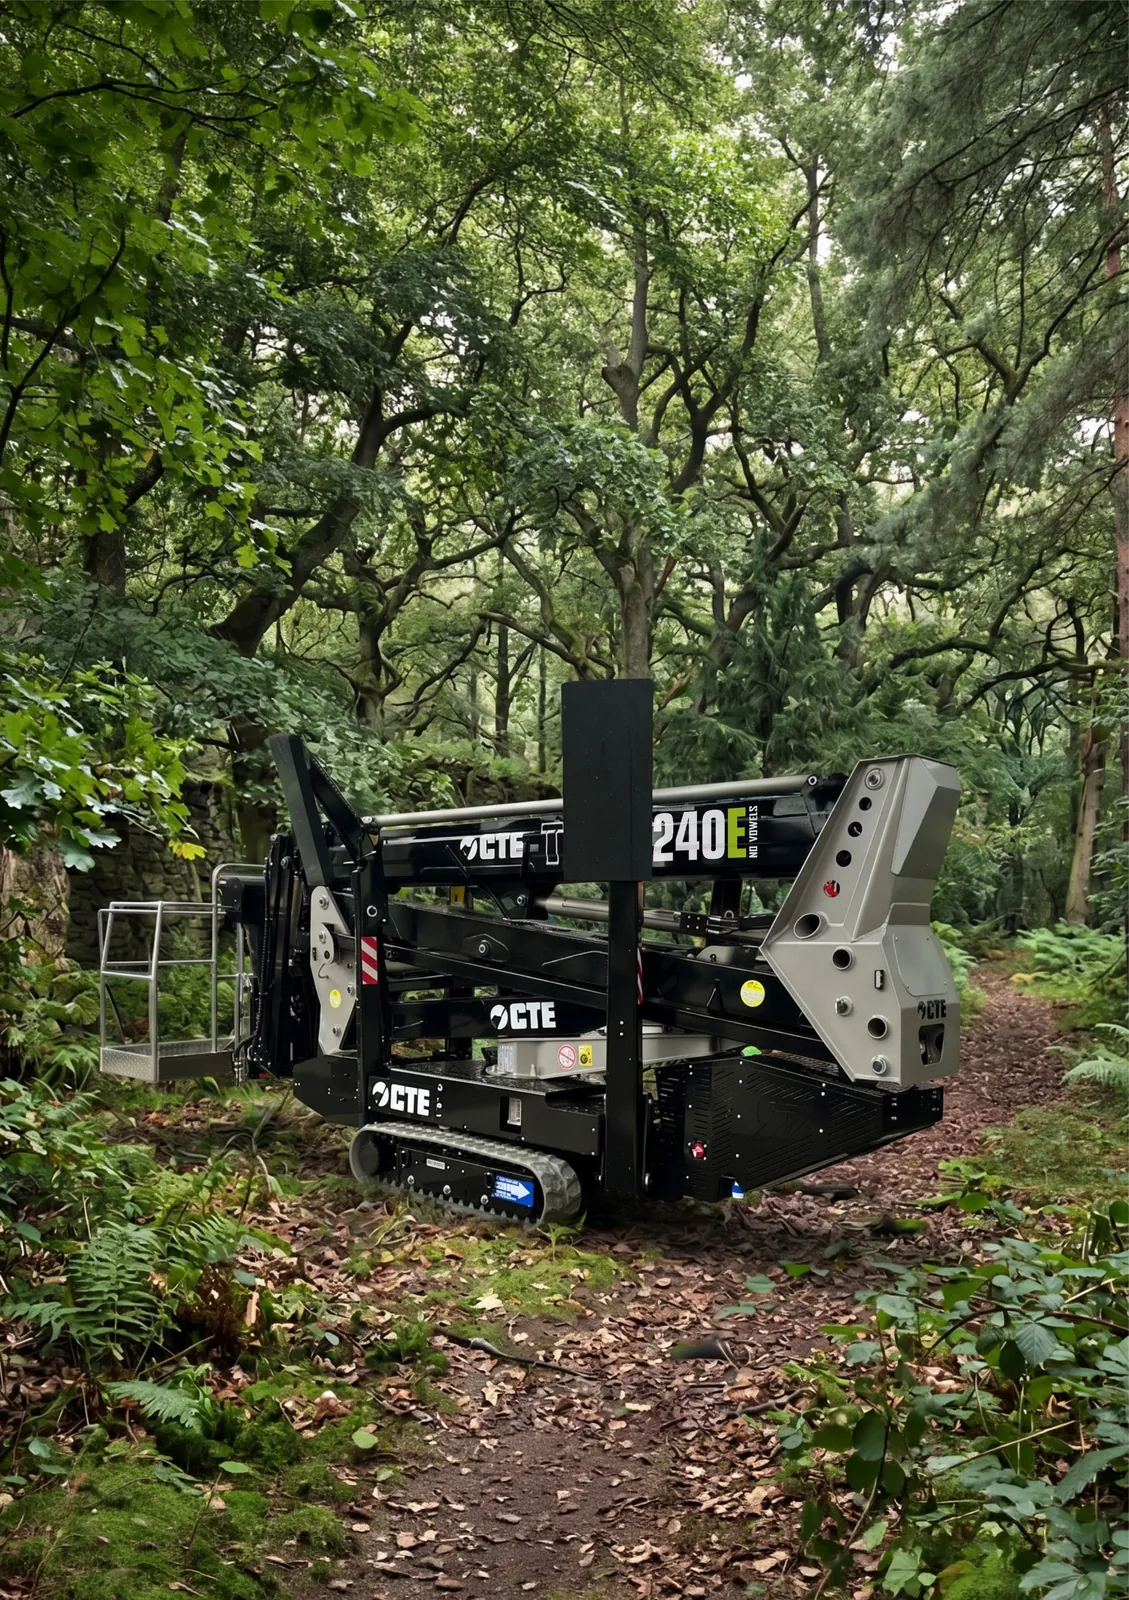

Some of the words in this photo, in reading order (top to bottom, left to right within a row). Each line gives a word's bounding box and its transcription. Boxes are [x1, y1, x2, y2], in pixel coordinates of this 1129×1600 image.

[653, 807, 747, 862] 240E
[748, 805, 758, 843] VOWELS
[480, 832, 524, 860] CTE
[748, 845, 758, 859] NO
[509, 1001, 557, 1030] CTE
[926, 999, 947, 1020] CTE
[390, 1083, 430, 1117] CTE
